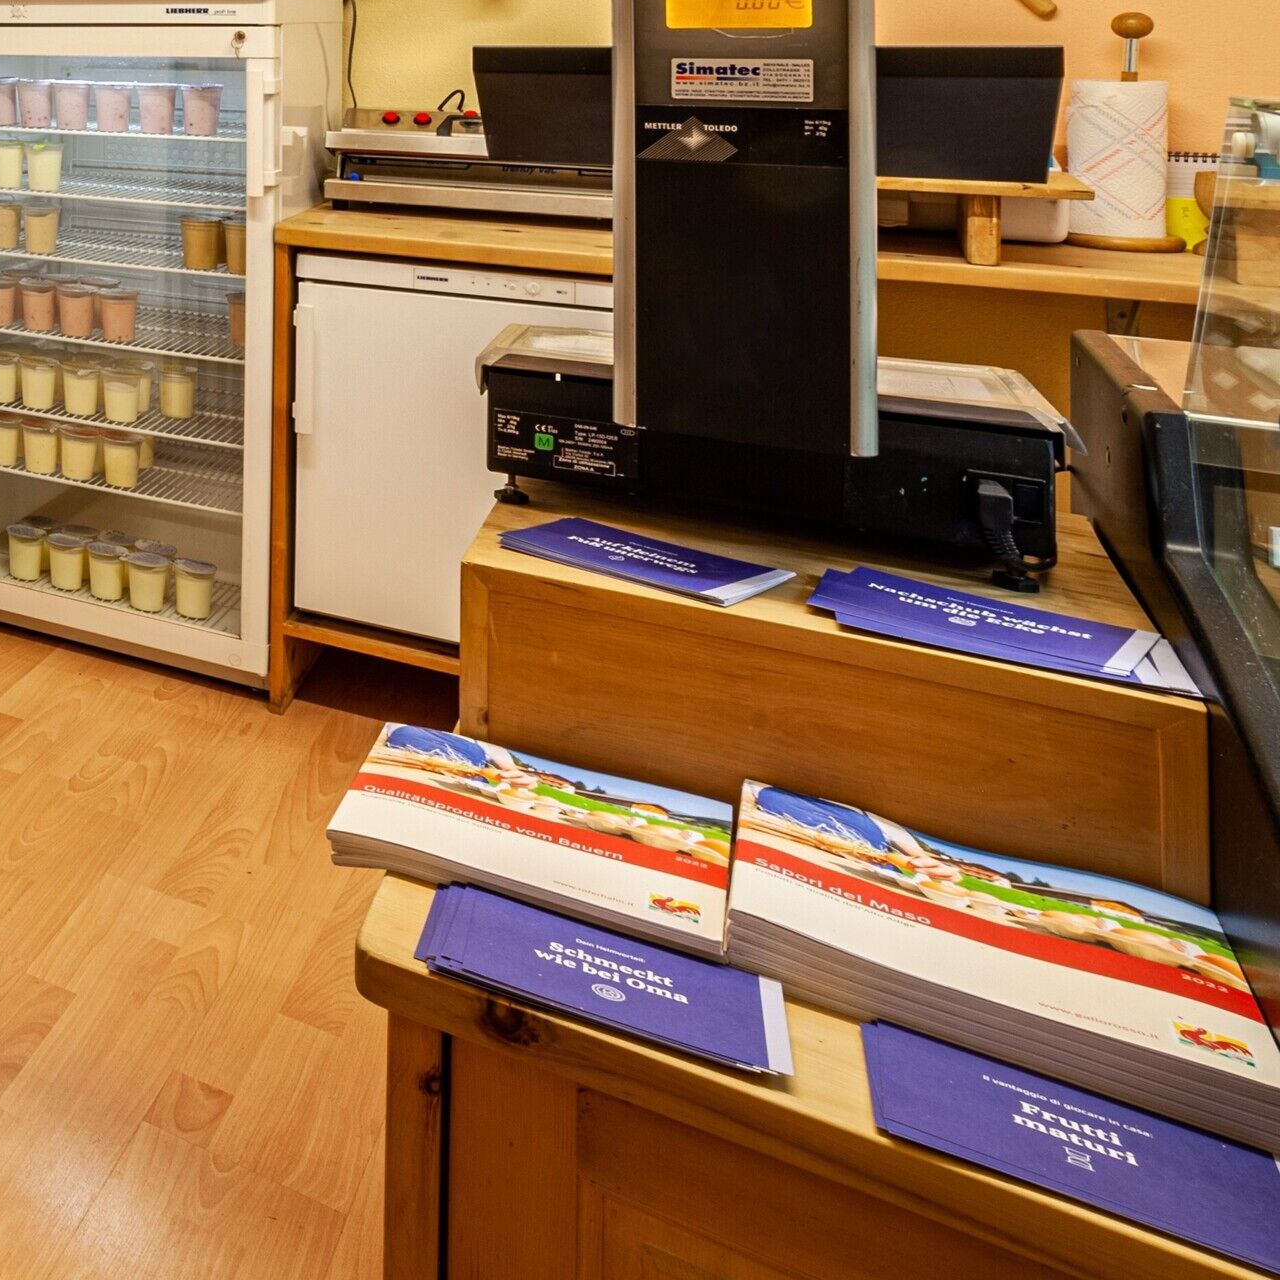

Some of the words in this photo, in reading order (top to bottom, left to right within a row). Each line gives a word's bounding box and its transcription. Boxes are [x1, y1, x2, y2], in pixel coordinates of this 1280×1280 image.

[675, 61, 761, 76] Simatec
[644, 122, 683, 130] METTLER
[703, 124, 738, 132] TOLEDO
[416, 275, 449, 283] LIEBHERR
[538, 436, 550, 447] M
[868, 582, 997, 619] Nachschub
[1001, 615, 1094, 640] wächst
[898, 596, 938, 610] um
[942, 607, 981, 620] die
[985, 616, 1046, 635] Ecke
[363, 784, 512, 830] Qualitätsprodukte
[515, 825, 553, 842] vom
[557, 837, 624, 860] Bauern
[754, 857, 823, 889] Sapori
[828, 885, 863, 904] del
[869, 899, 932, 926] Maso
[534, 948, 577, 969] wie
[582, 962, 621, 984] bei
[625, 977, 689, 1005] Oma
[549, 941, 674, 988] Schmeckt
[1181, 972, 1229, 994] 2022
[1037, 1001, 1160, 1041] www.gallorosso.it
[991, 1078, 1048, 1102] vantaggio
[1050, 1097, 1061, 1106] di
[1063, 1103, 1108, 1123] giocare
[1108, 1118, 1121, 1127] in
[1122, 1122, 1154, 1139] casa:
[1018, 1100, 1123, 1147] Frutti
[1011, 1113, 1140, 1167] maturi
